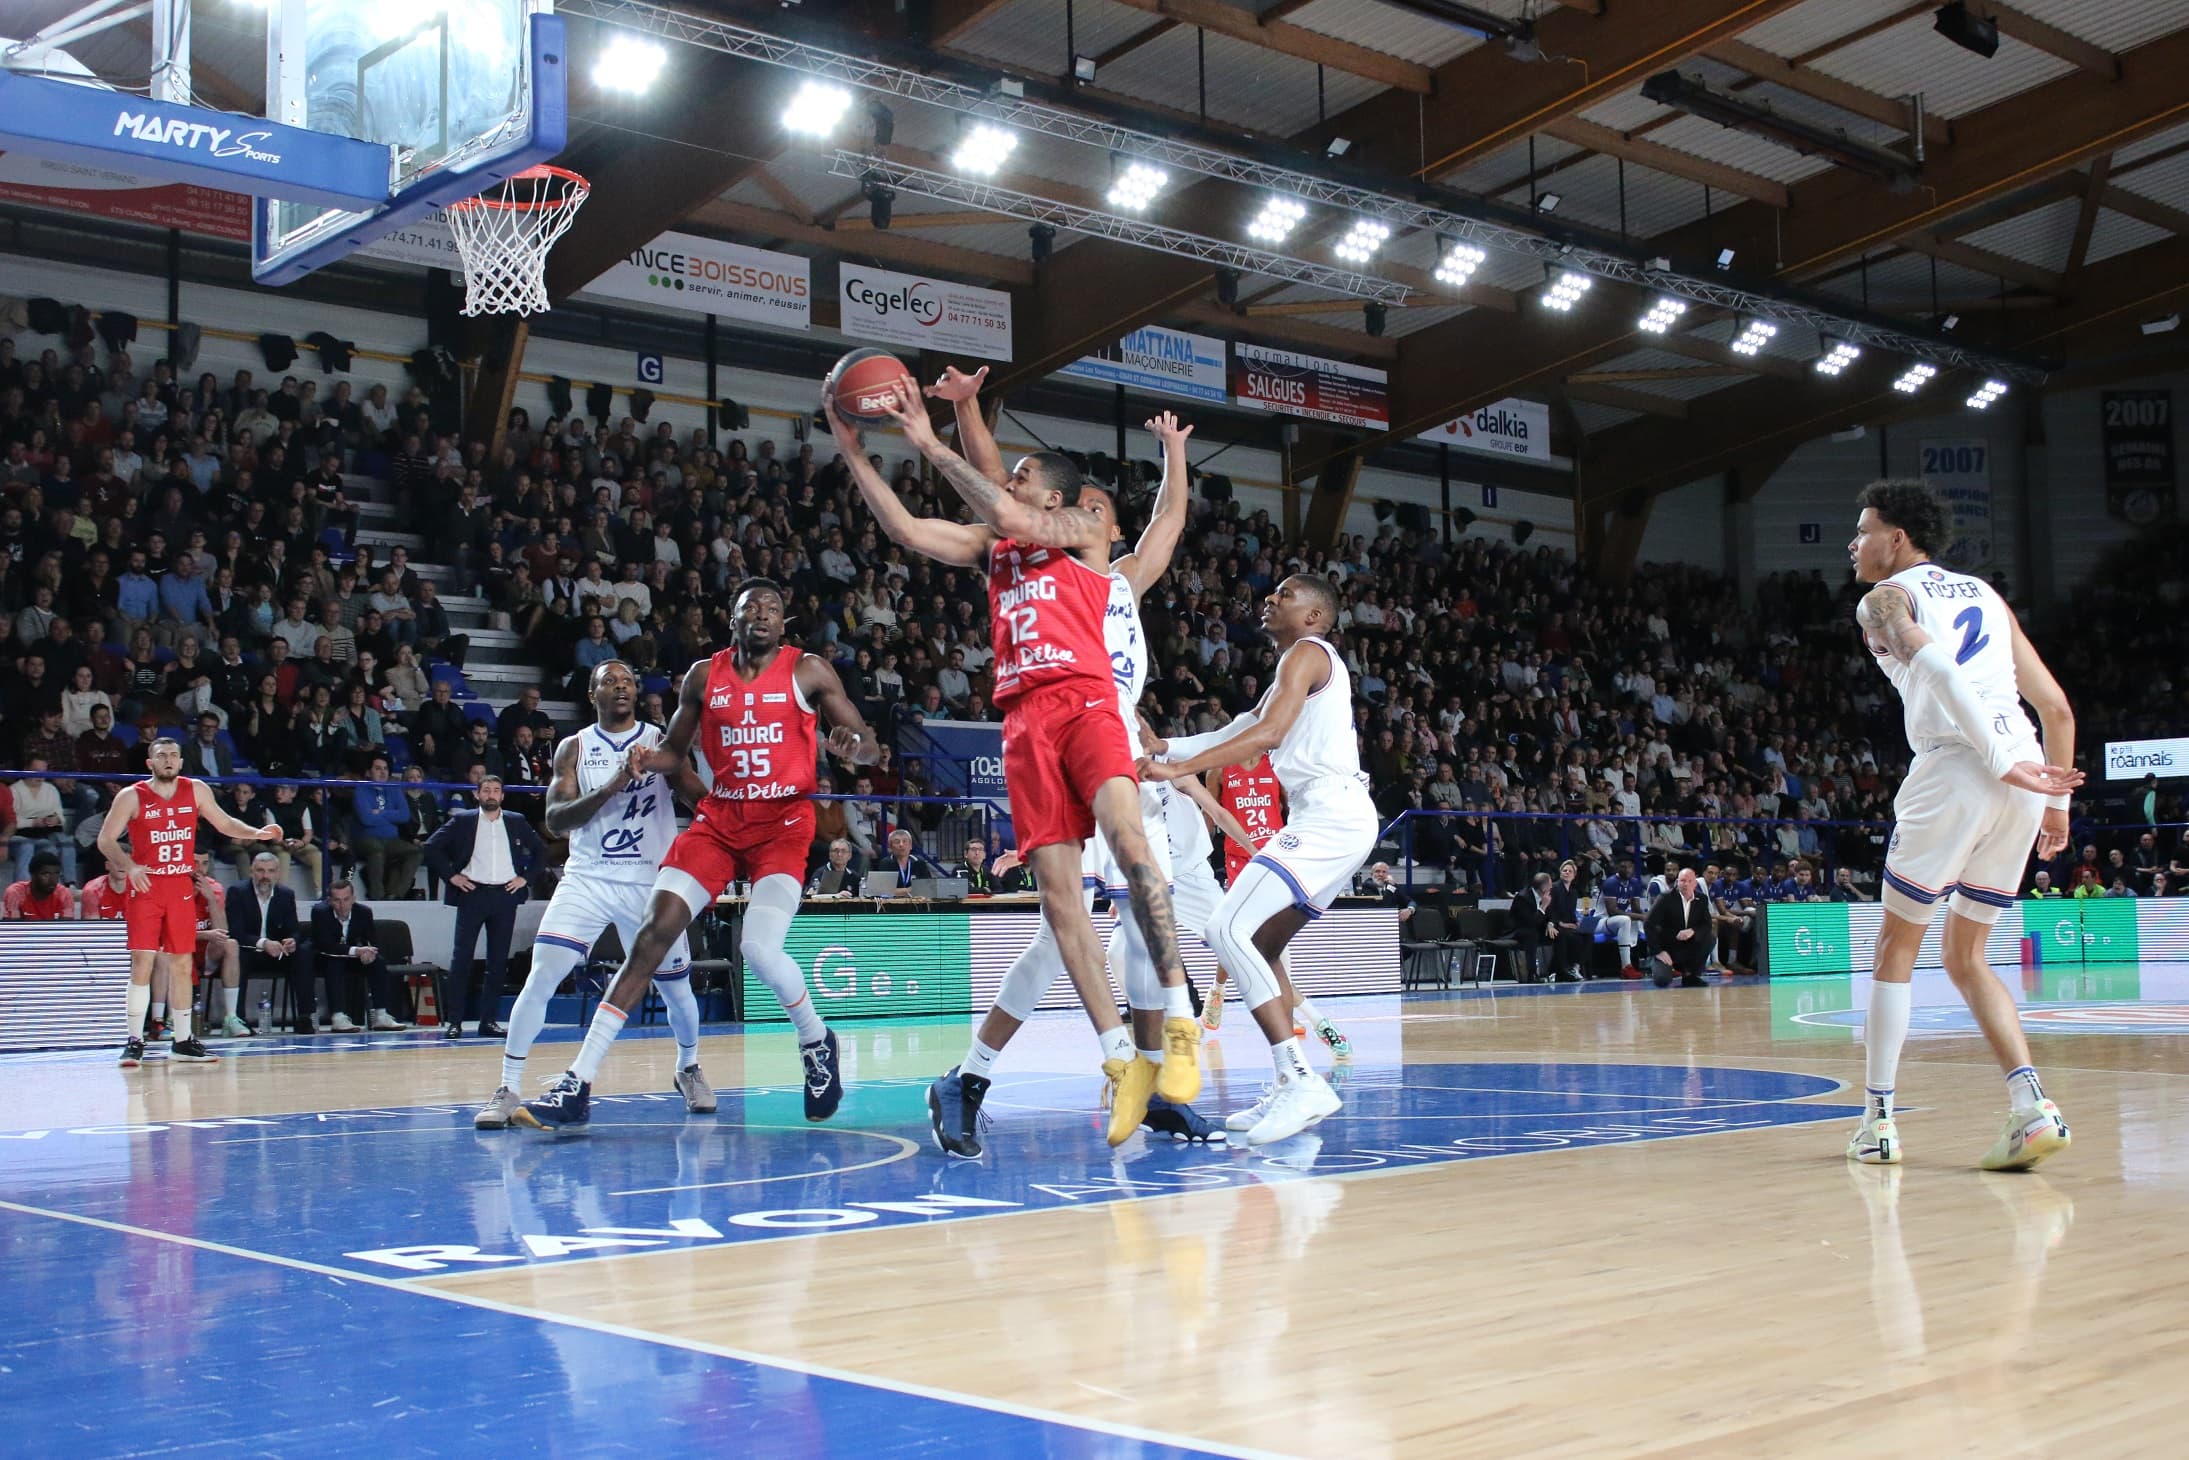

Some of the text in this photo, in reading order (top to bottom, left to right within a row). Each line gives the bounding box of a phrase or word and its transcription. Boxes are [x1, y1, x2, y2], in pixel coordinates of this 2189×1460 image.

[113, 111, 231, 151] MARTY
[688, 257, 807, 297] BOISSONS
[845, 278, 936, 316] Cegelec
[948, 312, 1007, 330] 04 77 71 50 35
[1124, 328, 1194, 364] MATTANA
[1244, 344, 1339, 374] formations
[640, 356, 662, 381] G
[1125, 352, 1194, 377] MAÇONNERIE
[1247, 373, 1306, 405] SALGUES
[1338, 414, 1367, 428] SECOURS
[1476, 408, 1528, 440] dalkia
[2105, 399, 2169, 427] 2007
[1923, 447, 1985, 474] 2007
[998, 576, 1057, 618] BOURG
[1920, 581, 1984, 599] FOSTER
[1009, 606, 1040, 646] 12
[1952, 605, 1990, 667] 2
[710, 694, 730, 707] AIN
[720, 722, 783, 747] BOURG
[731, 748, 771, 778] 35
[2111, 750, 2173, 769] roannais
[747, 781, 799, 800] Délice
[1235, 794, 1271, 810] BOURG
[622, 794, 657, 821] 42
[1245, 809, 1267, 827] 24
[150, 827, 191, 844] BOURG
[158, 844, 183, 863] 83
[343, 1116, 1772, 1271] RAVON AUTOMOBILE
